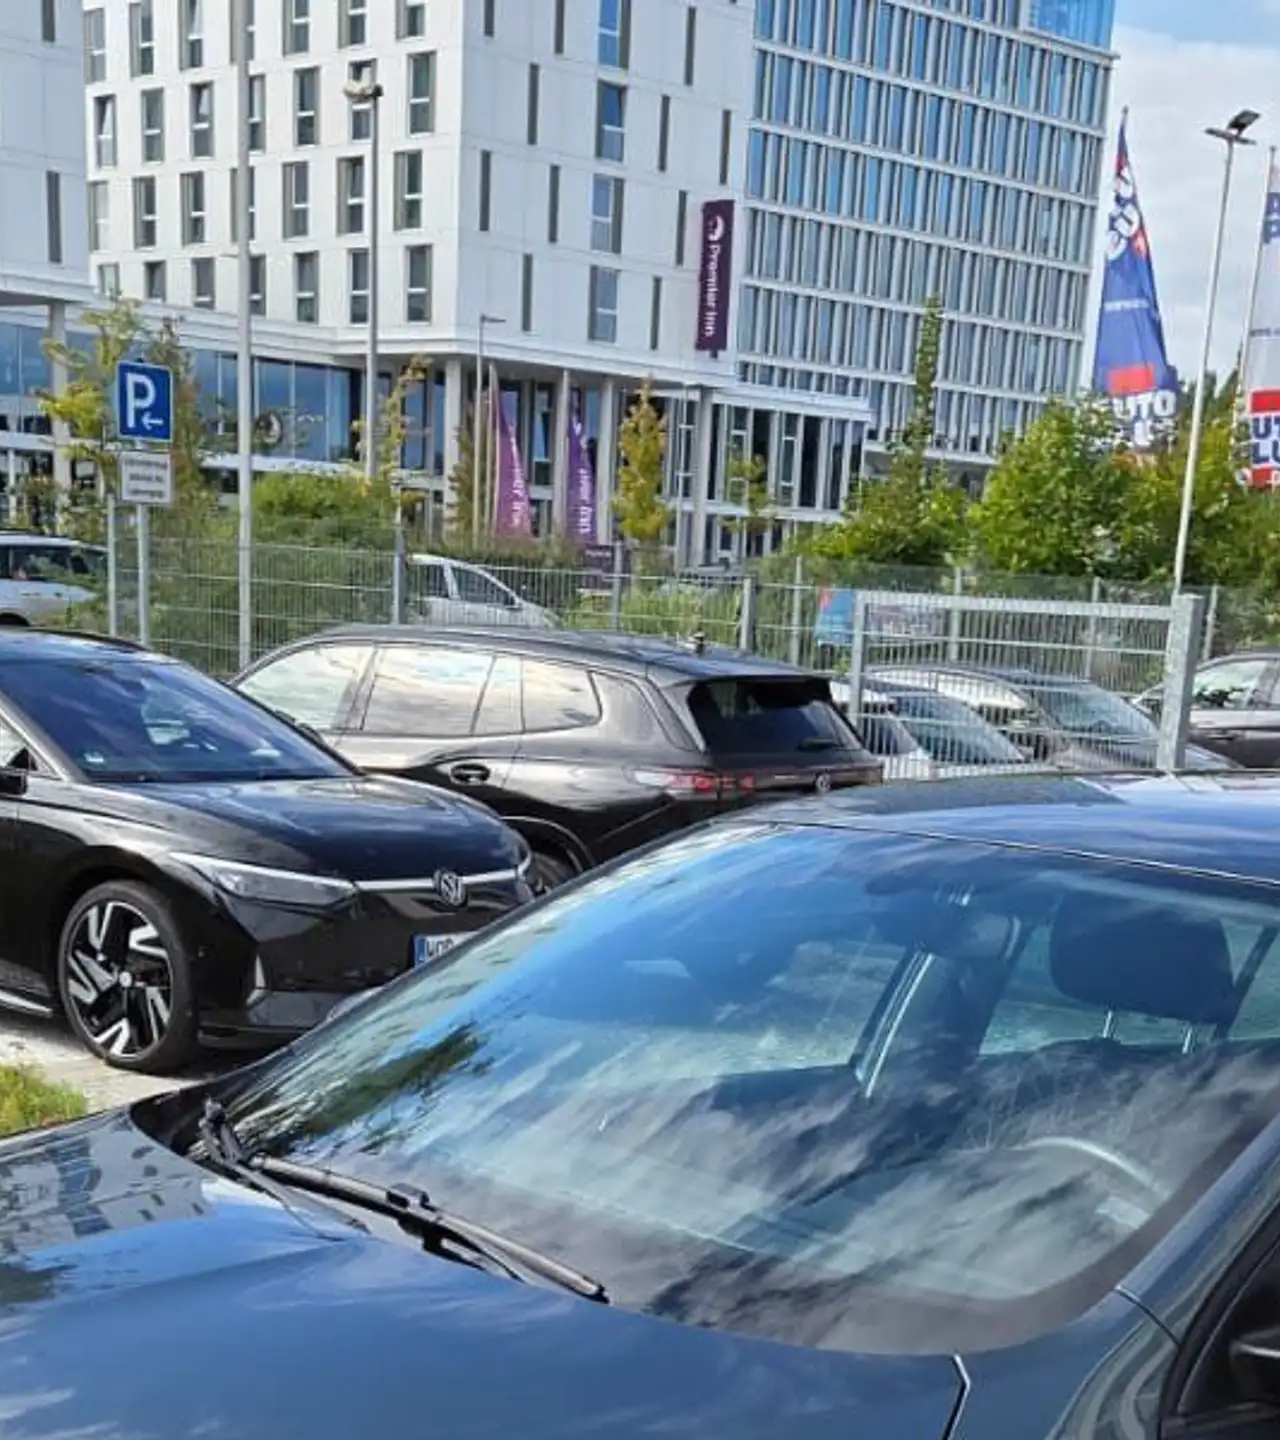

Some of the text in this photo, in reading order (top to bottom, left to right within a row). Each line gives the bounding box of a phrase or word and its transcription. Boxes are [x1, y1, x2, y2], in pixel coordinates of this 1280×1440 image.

[703, 243, 722, 337] Premier Inn
[126, 372, 157, 429] P
